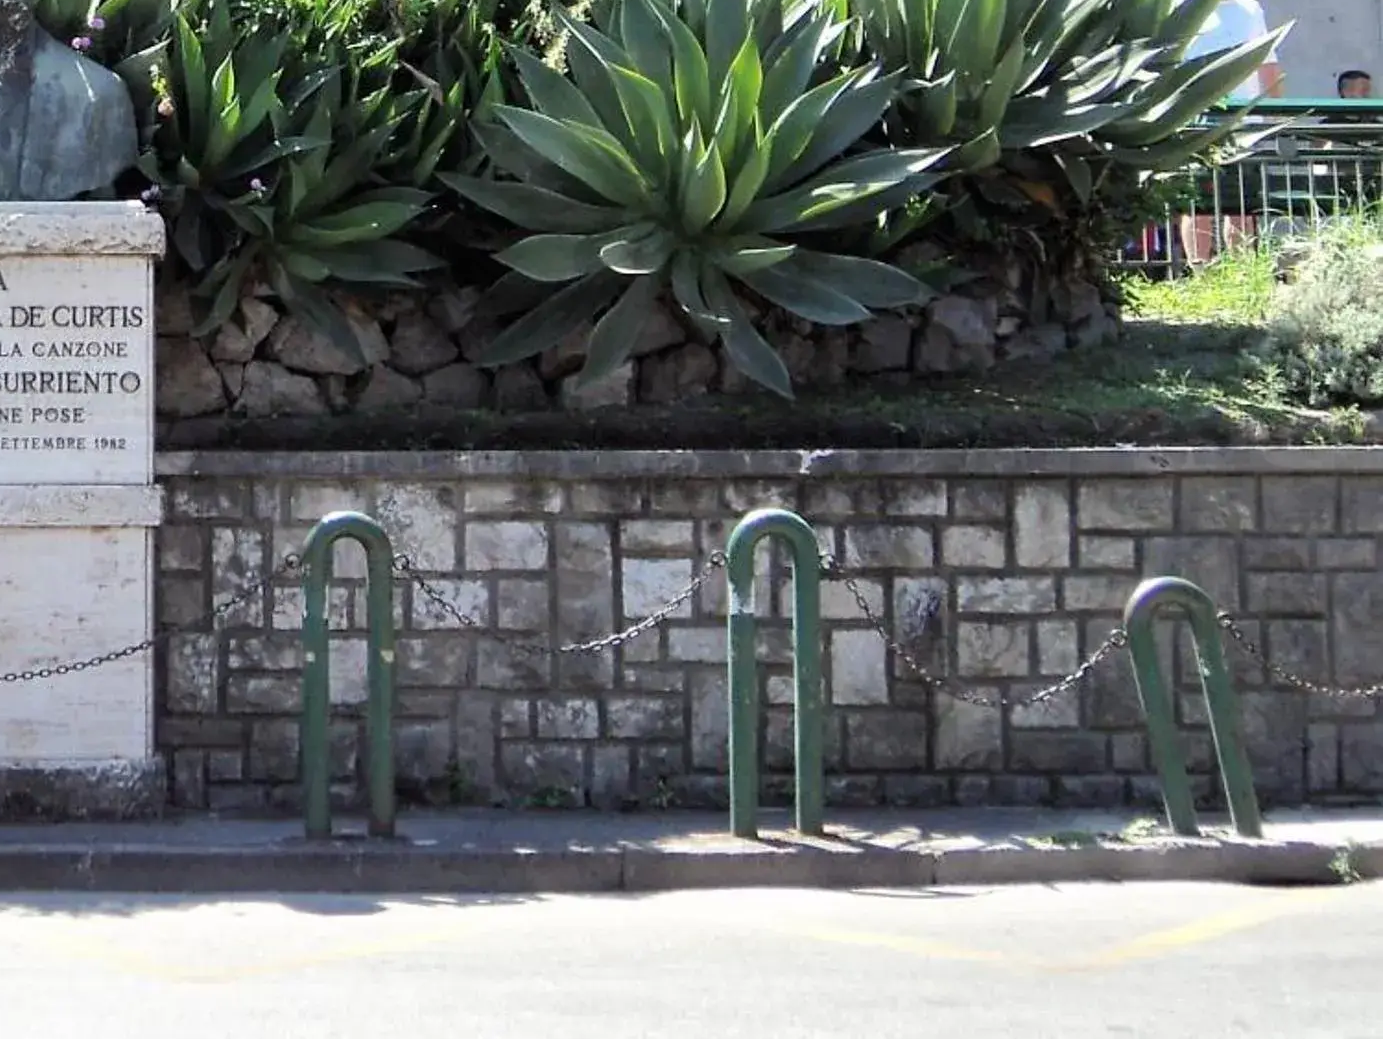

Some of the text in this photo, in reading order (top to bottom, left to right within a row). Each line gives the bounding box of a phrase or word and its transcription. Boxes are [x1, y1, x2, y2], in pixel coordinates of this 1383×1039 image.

[9, 306, 46, 328] DE
[52, 305, 144, 328] CURTIS
[32, 341, 128, 358] CANZONE
[31, 407, 86, 424] POSE
